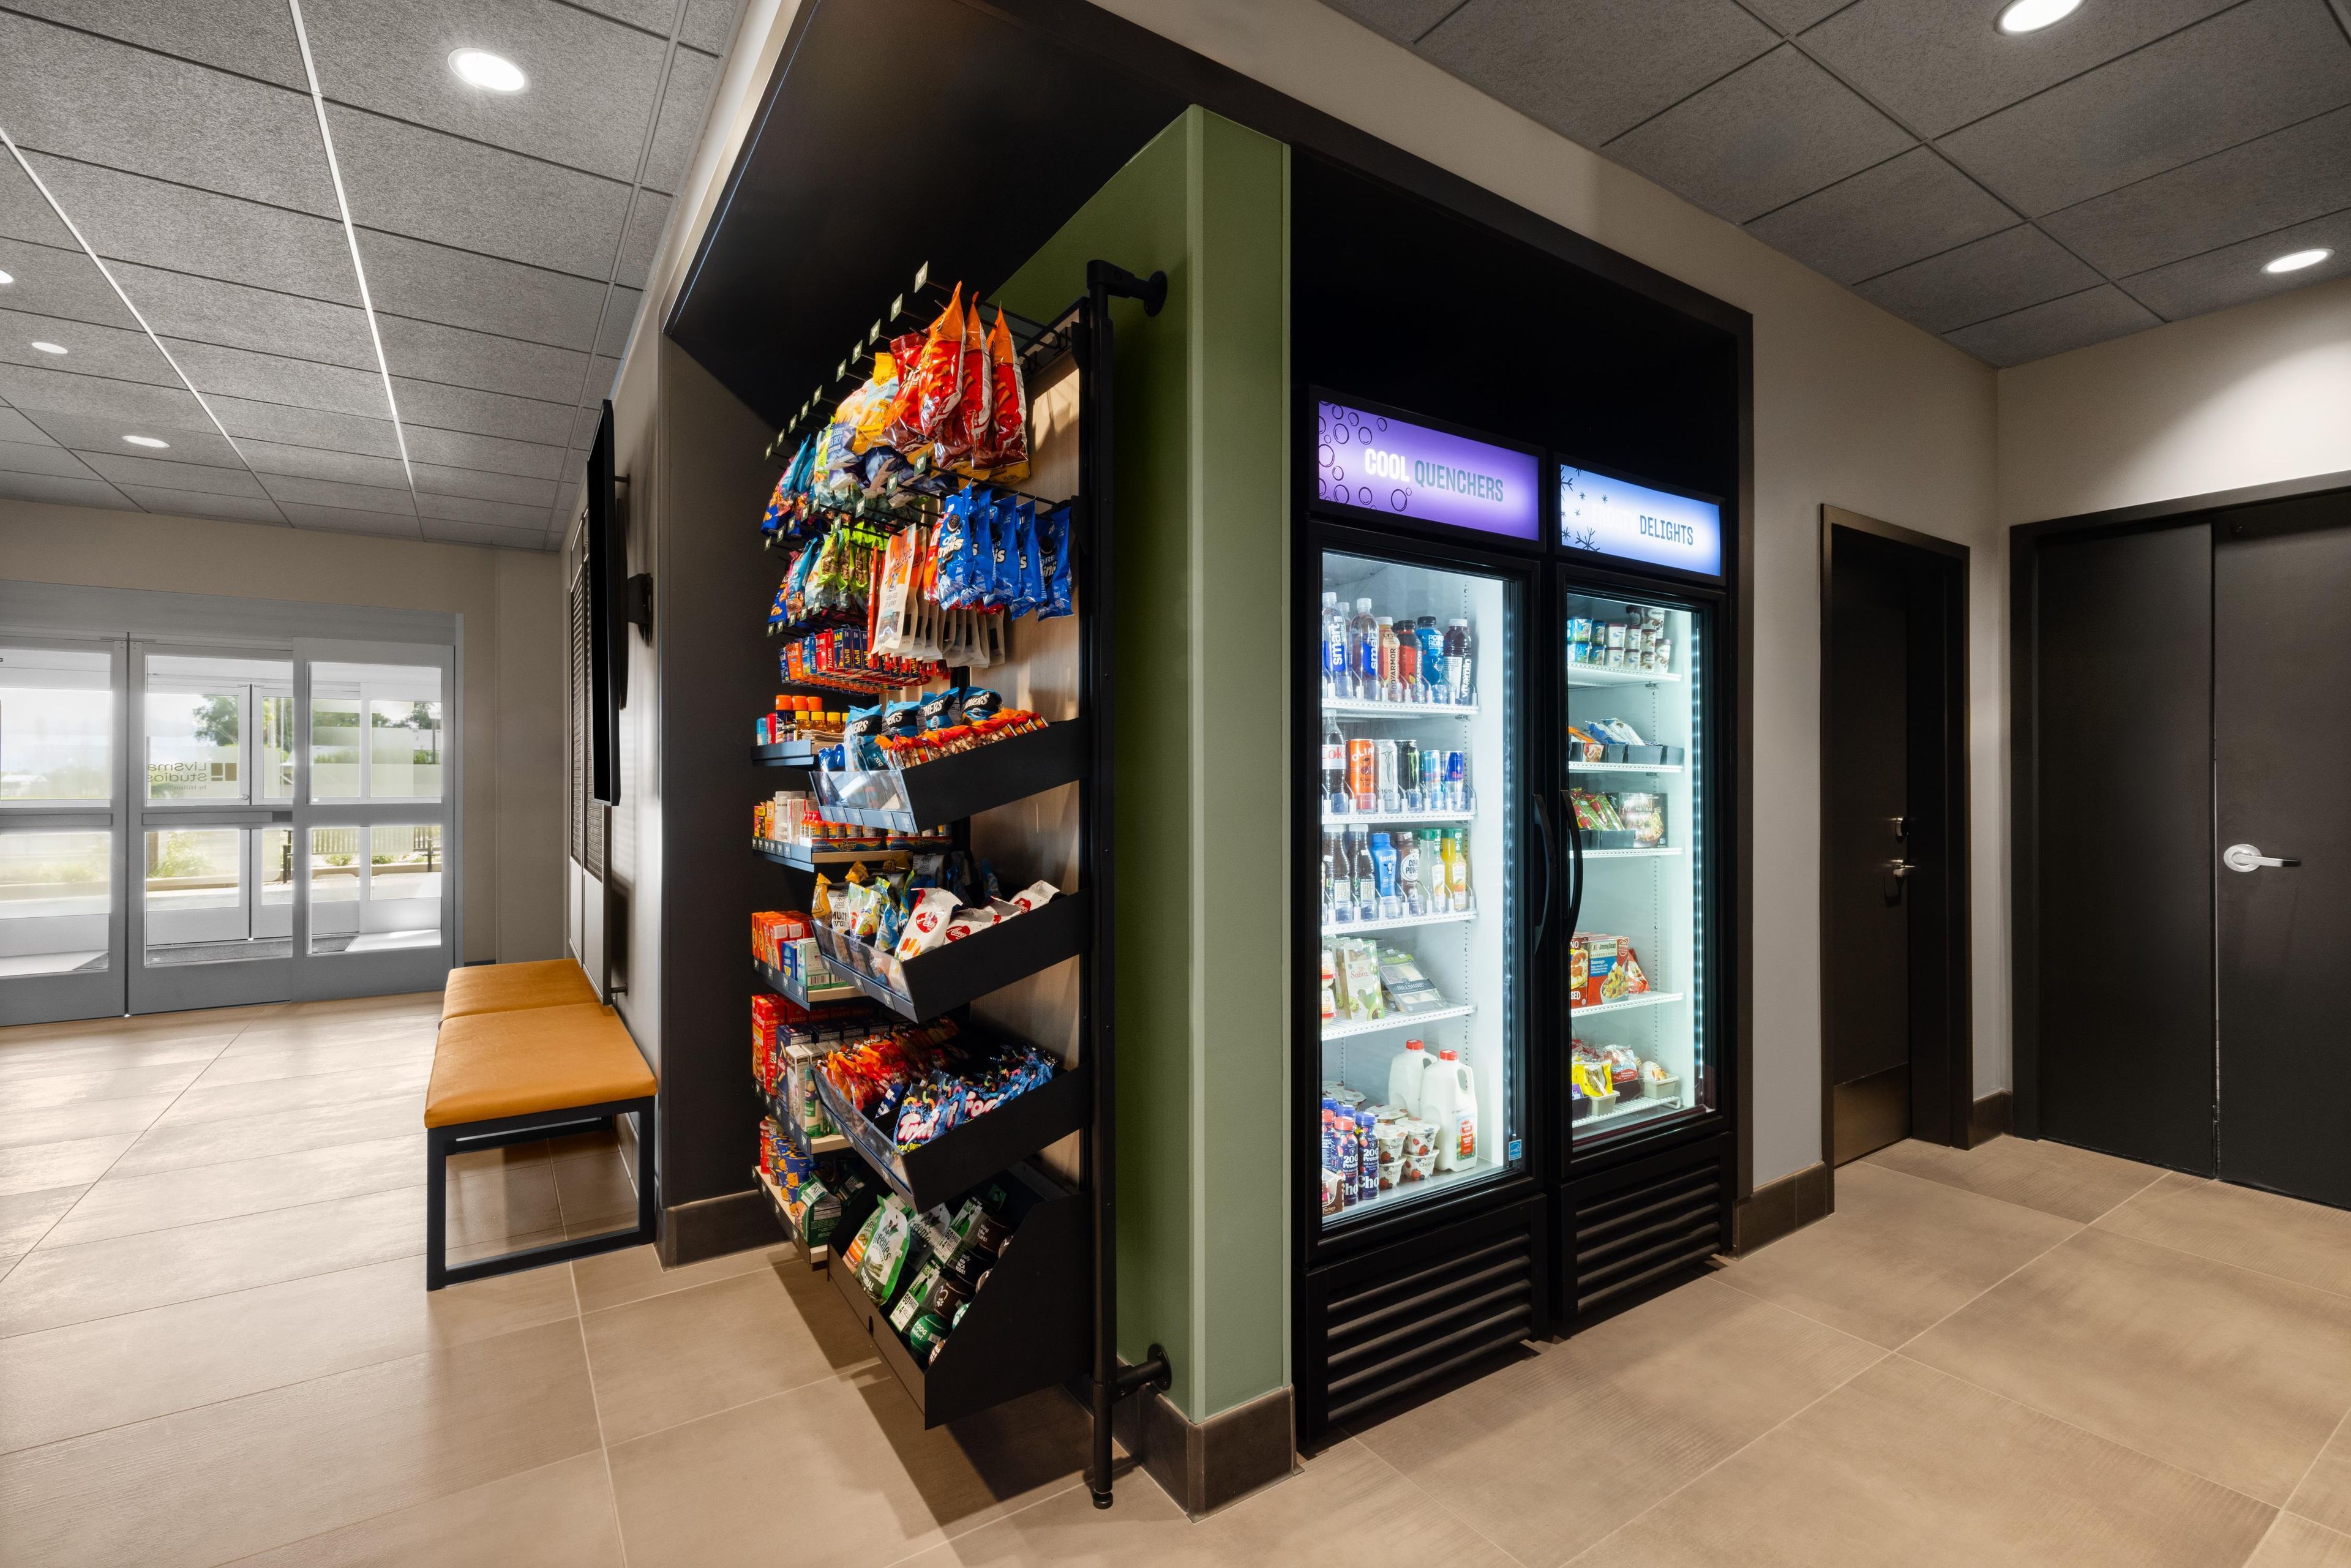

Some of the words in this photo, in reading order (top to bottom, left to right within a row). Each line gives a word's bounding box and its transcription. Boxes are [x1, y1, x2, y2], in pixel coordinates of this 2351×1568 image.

[1365, 448, 1410, 482] COOL
[1414, 460, 1504, 502] QUENCHERS
[1640, 515, 1694, 546] DELIGHTS
[1330, 623, 1343, 666] smart
[1461, 658, 1472, 698] vitamin
[924, 700, 943, 716] NERS
[1363, 890, 1374, 899] PEA
[1397, 982, 1425, 991] HILLSHIRE
[945, 1229, 953, 1240] 60
[952, 1233, 961, 1244] BAGS
[902, 1293, 909, 1305] 60
[909, 1299, 918, 1310] BAGS
[898, 1306, 905, 1315] 4
